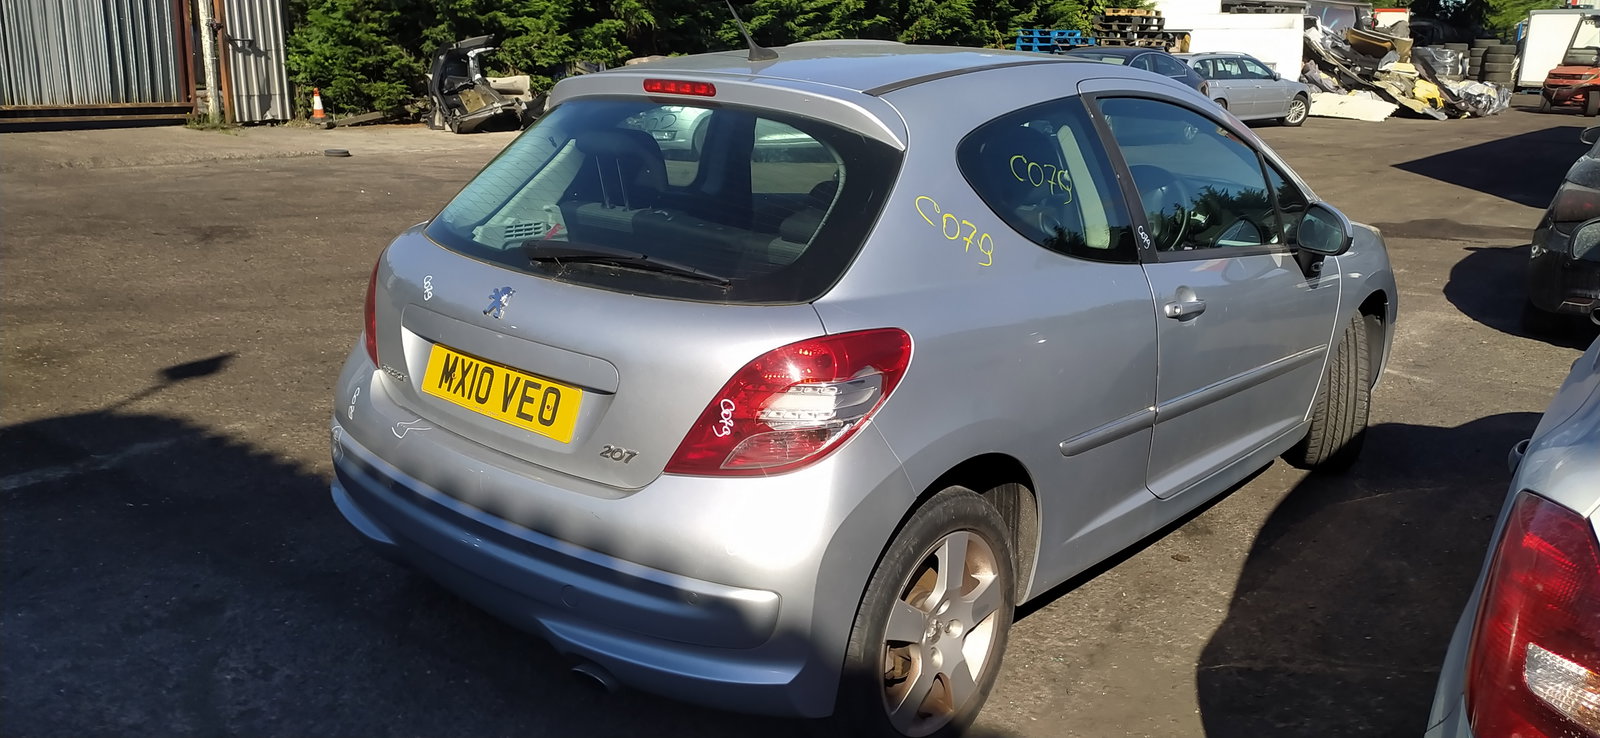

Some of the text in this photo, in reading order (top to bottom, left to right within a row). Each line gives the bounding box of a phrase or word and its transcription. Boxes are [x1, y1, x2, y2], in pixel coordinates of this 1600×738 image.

[437, 353, 561, 427] MX10 VEO
[600, 444, 639, 464] 207
